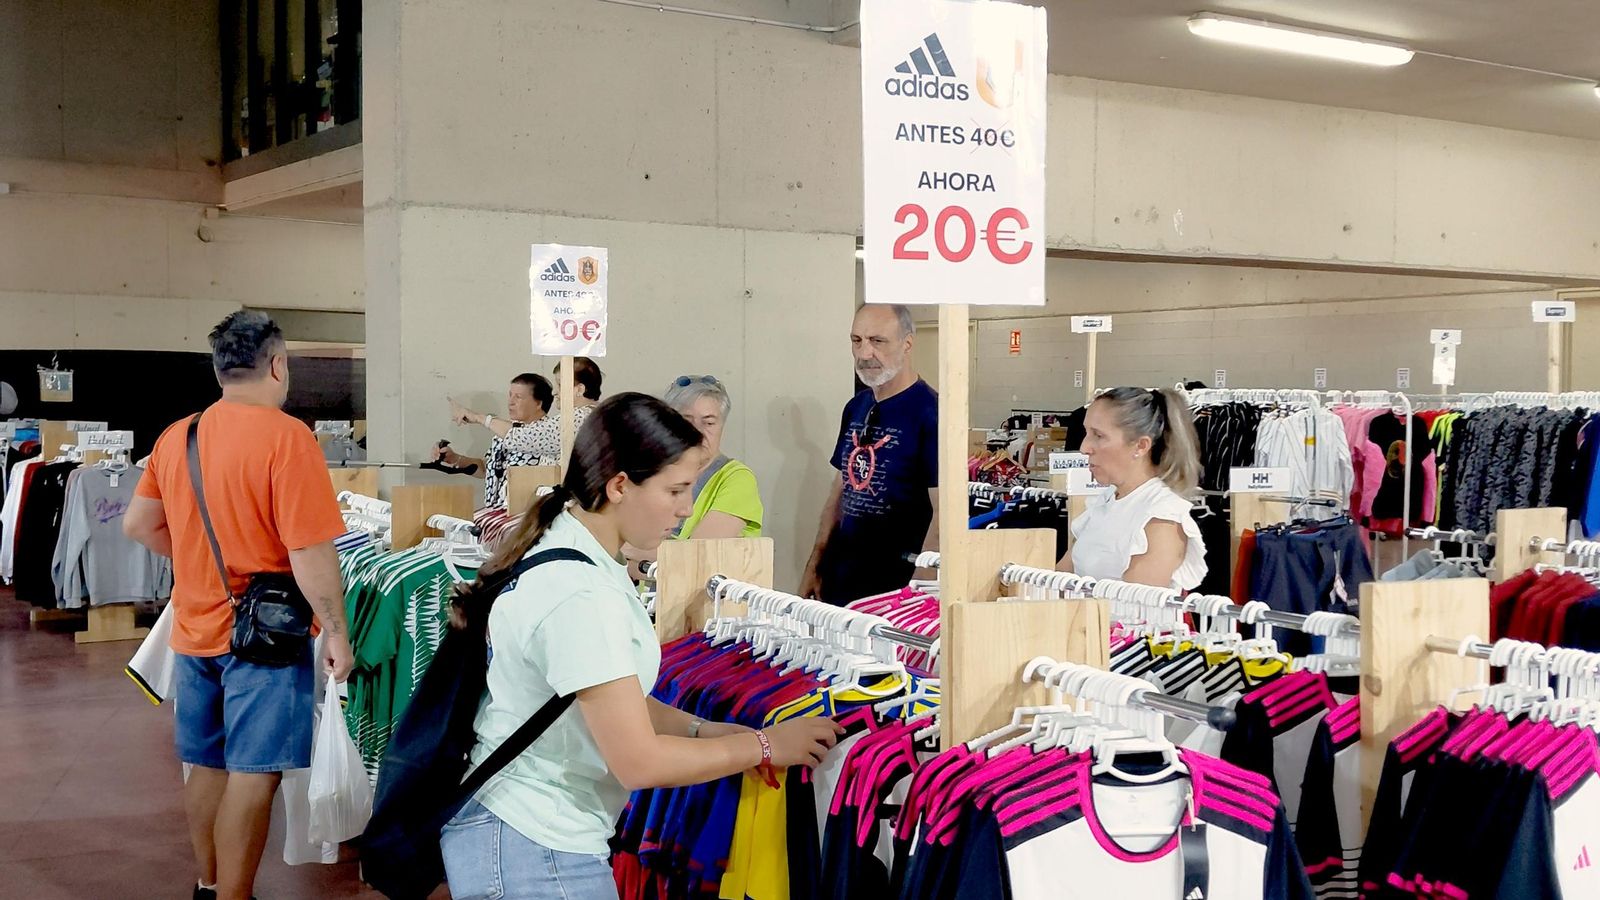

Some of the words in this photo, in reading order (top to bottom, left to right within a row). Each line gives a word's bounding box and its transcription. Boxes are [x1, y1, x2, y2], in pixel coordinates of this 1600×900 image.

[885, 75, 969, 101] adidas
[895, 123, 965, 144] ANTES
[918, 171, 996, 192] AHORA
[893, 203, 1033, 264] 20€
[540, 273, 575, 282] adidas
[544, 319, 601, 341] 0€
[1252, 473, 1269, 483] HH
